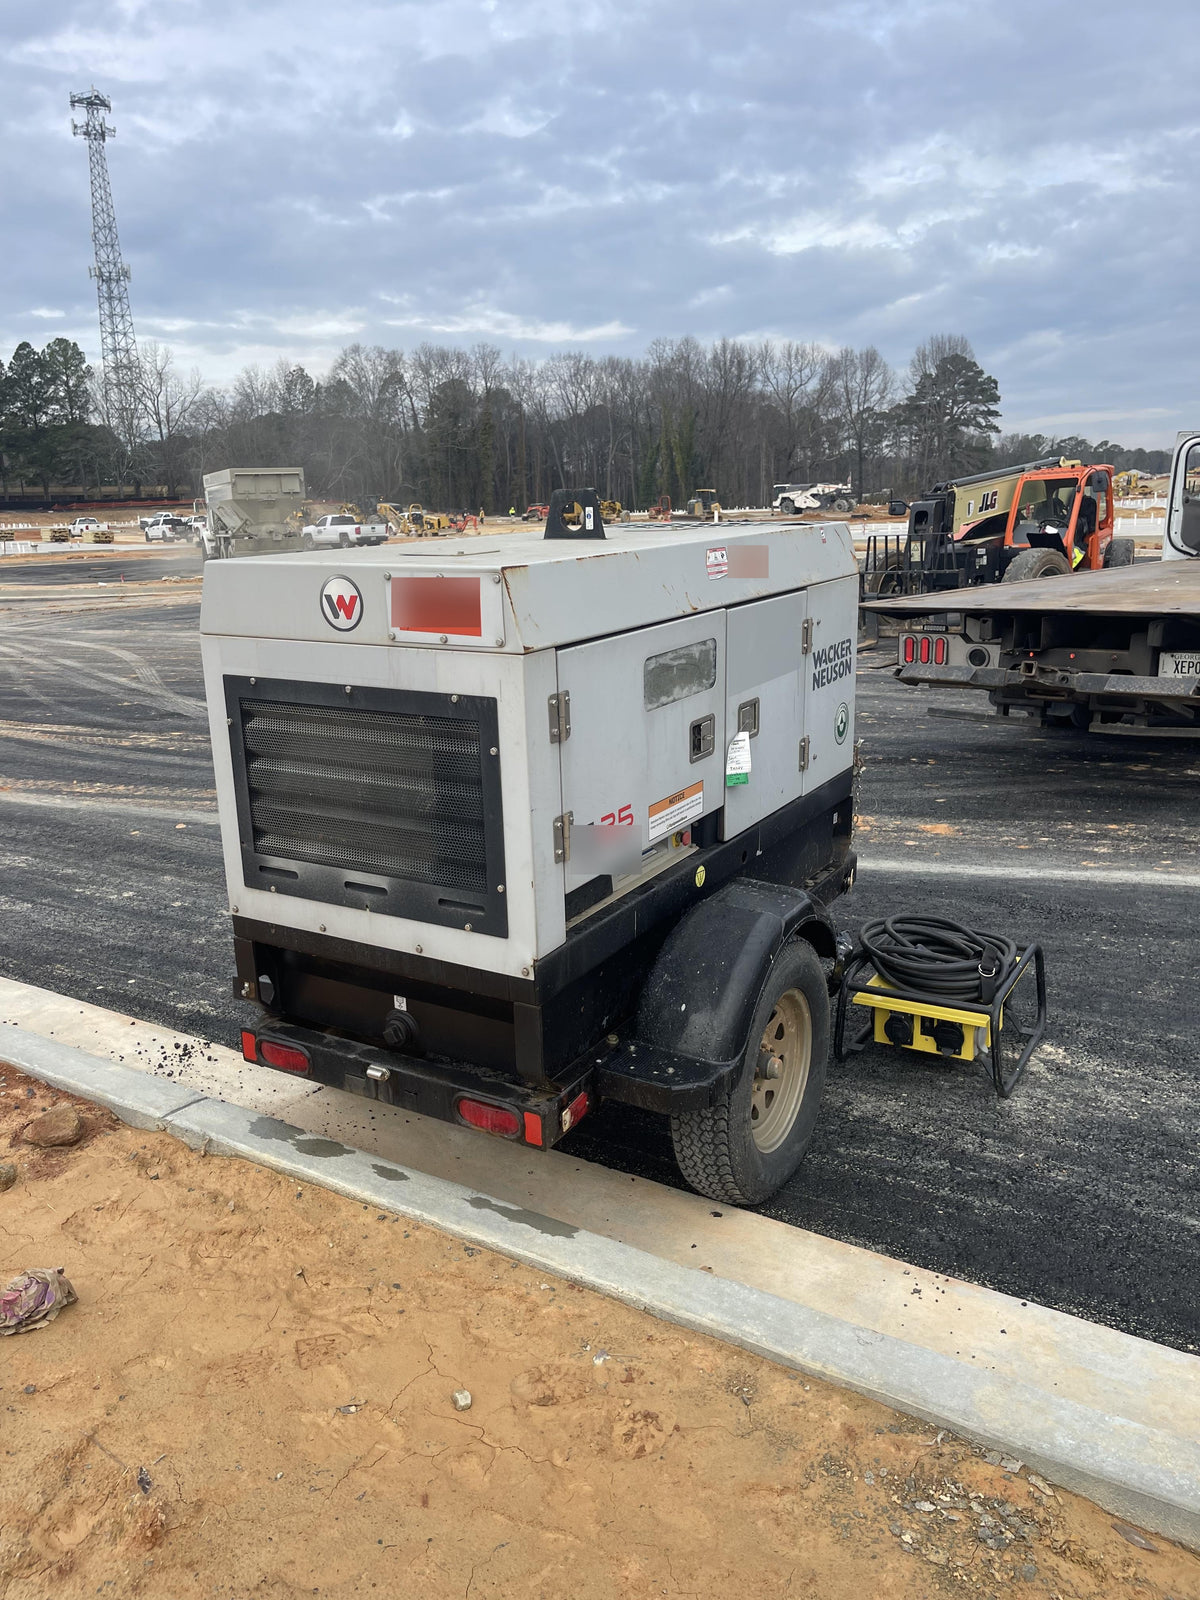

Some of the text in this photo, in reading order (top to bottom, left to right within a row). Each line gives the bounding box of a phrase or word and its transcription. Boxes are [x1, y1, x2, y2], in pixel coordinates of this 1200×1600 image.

[978, 490, 998, 513] JLG
[812, 639, 852, 670] WACKER
[812, 657, 852, 691] NEUSON
[668, 791, 685, 805] NOTICE
